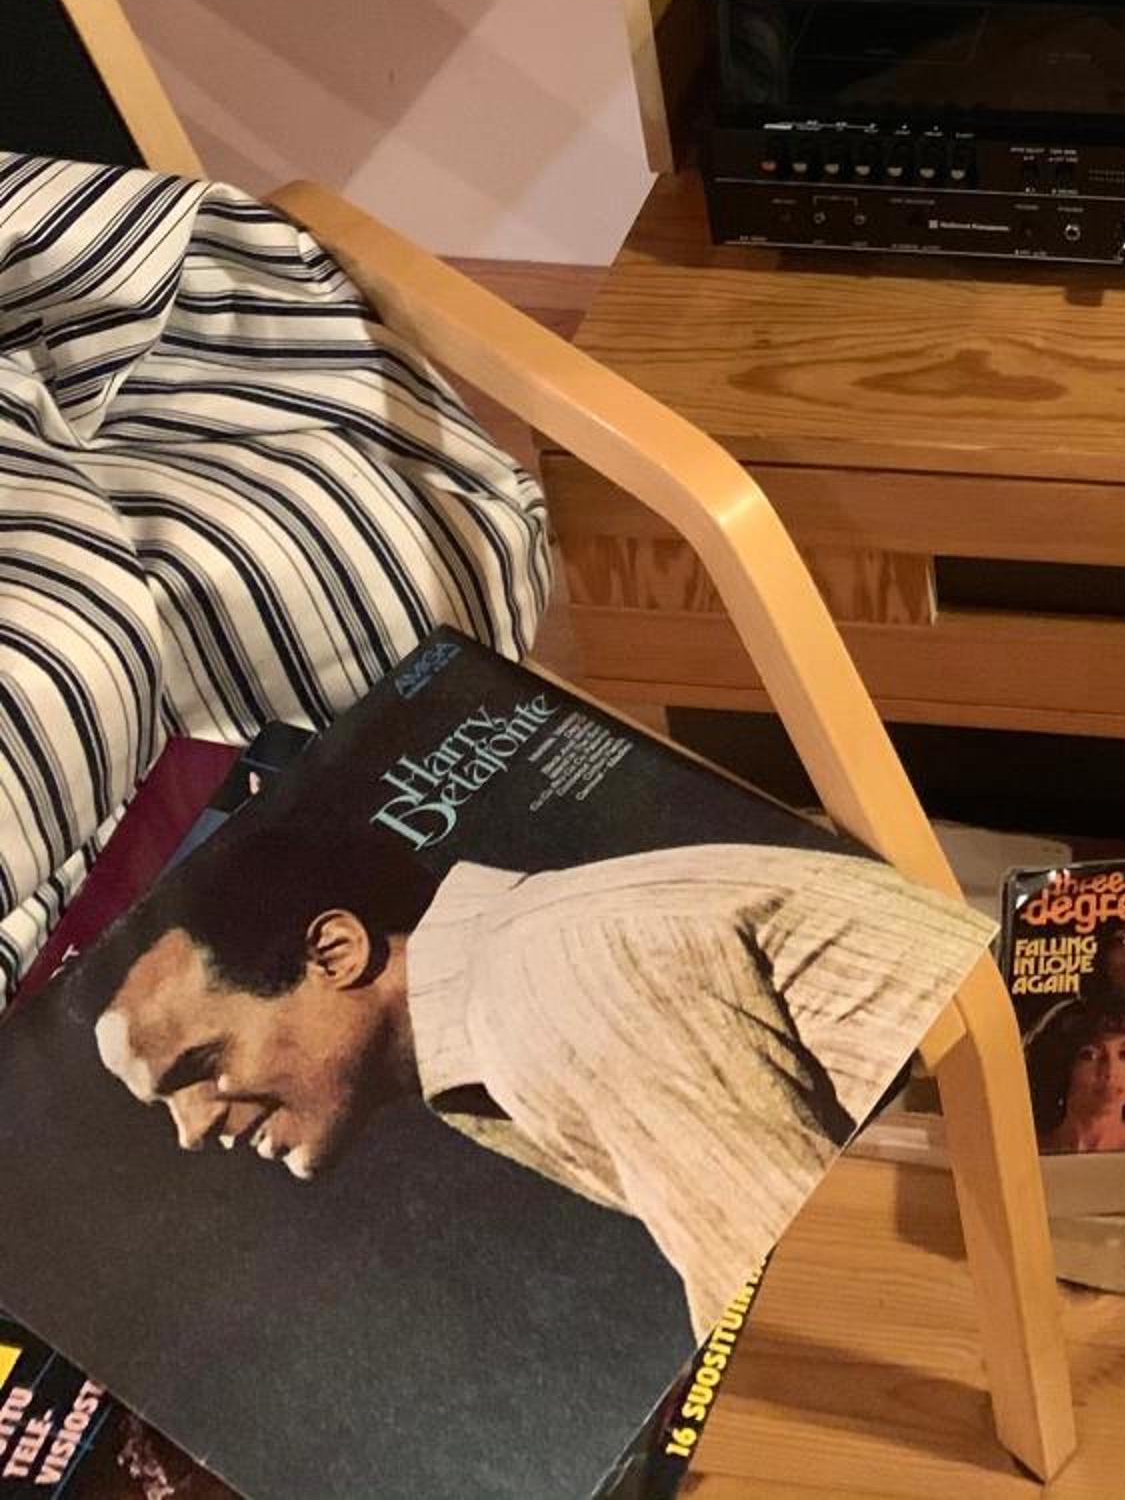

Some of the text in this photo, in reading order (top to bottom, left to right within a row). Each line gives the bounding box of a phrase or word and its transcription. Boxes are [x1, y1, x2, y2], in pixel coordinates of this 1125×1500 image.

[380, 706, 507, 796] Harry
[369, 694, 559, 851] Belafonte
[1015, 936, 1098, 956] FALLING
[1013, 954, 1095, 975] IN LOVE
[1012, 973, 1080, 994] AGAIN
[2, 1409, 54, 1478] TELE-
[665, 1426, 697, 1458] 16
